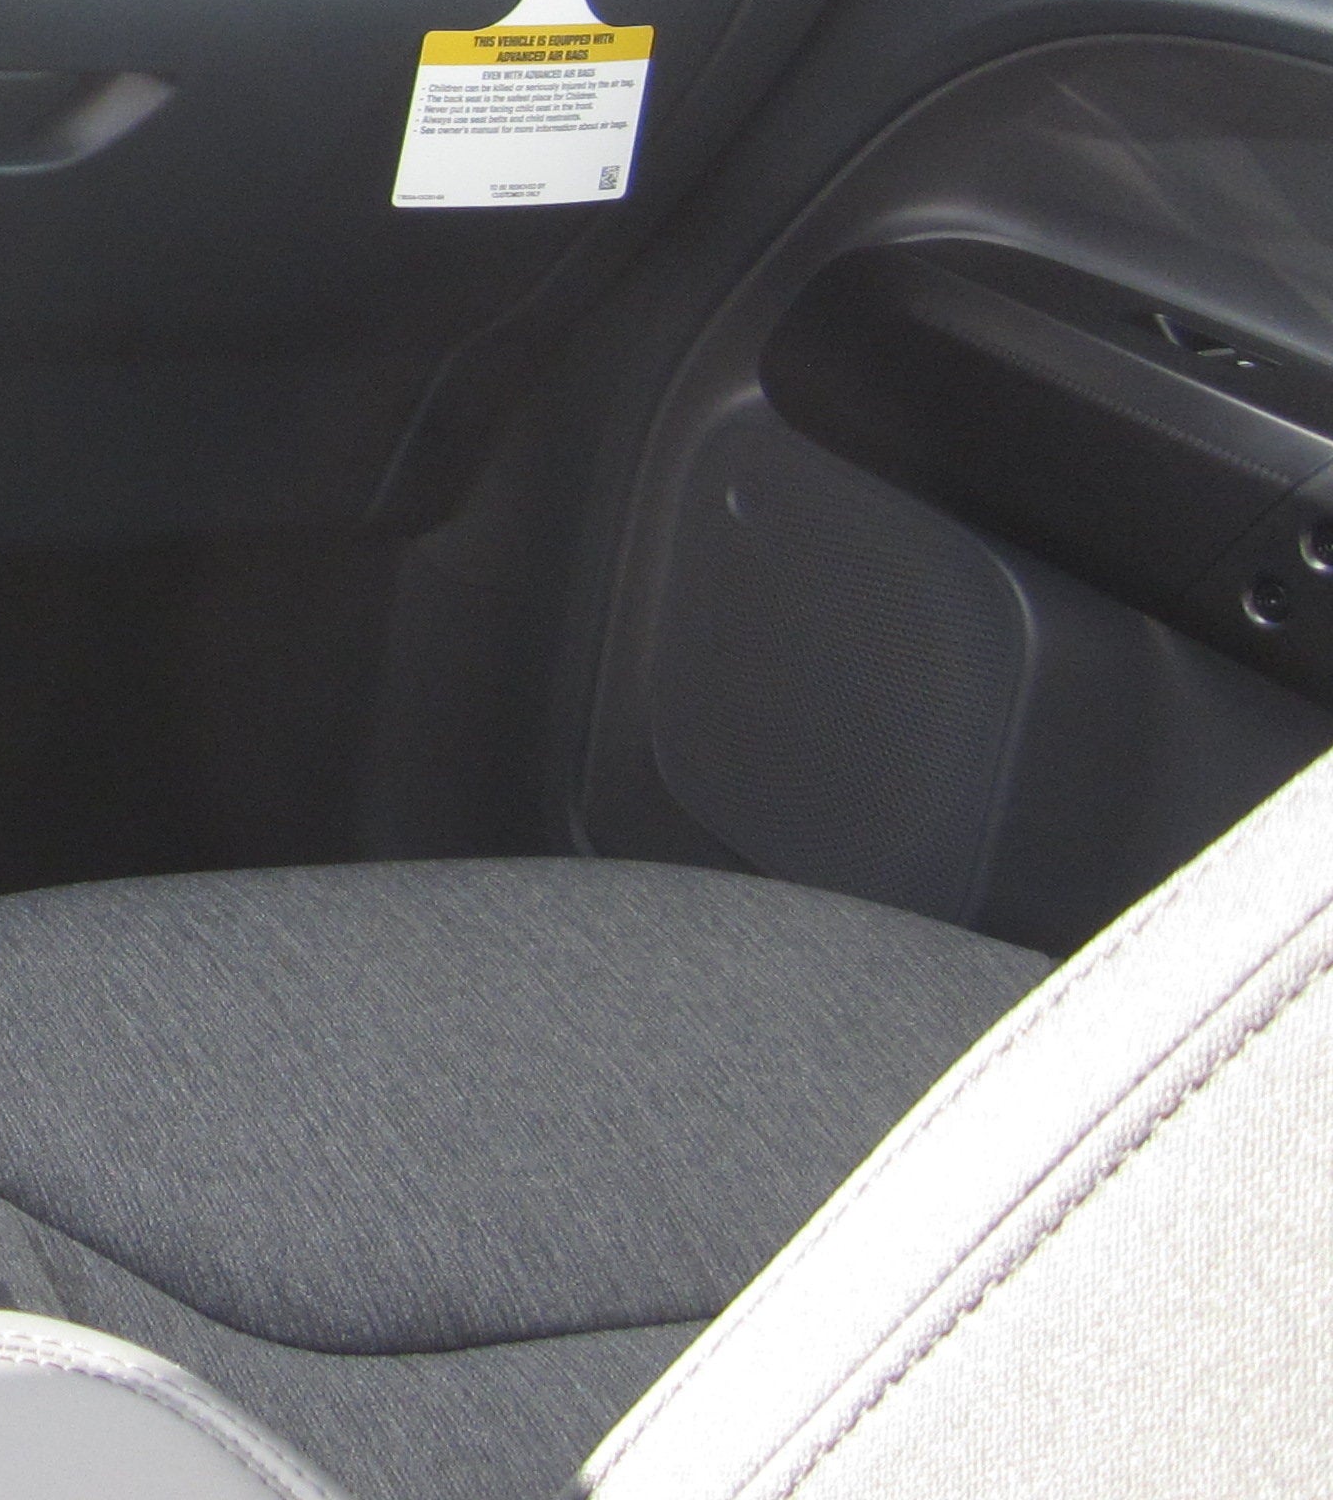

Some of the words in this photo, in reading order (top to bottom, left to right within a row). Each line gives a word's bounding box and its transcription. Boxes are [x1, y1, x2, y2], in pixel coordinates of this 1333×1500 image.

[474, 35, 496, 47] THIS
[498, 35, 535, 47] VEHICLE
[537, 35, 546, 46] IS
[548, 34, 591, 46] EQUIPPED
[496, 51, 546, 62] ADVANCED
[547, 50, 563, 61] AIR
[565, 49, 589, 60] BAGS
